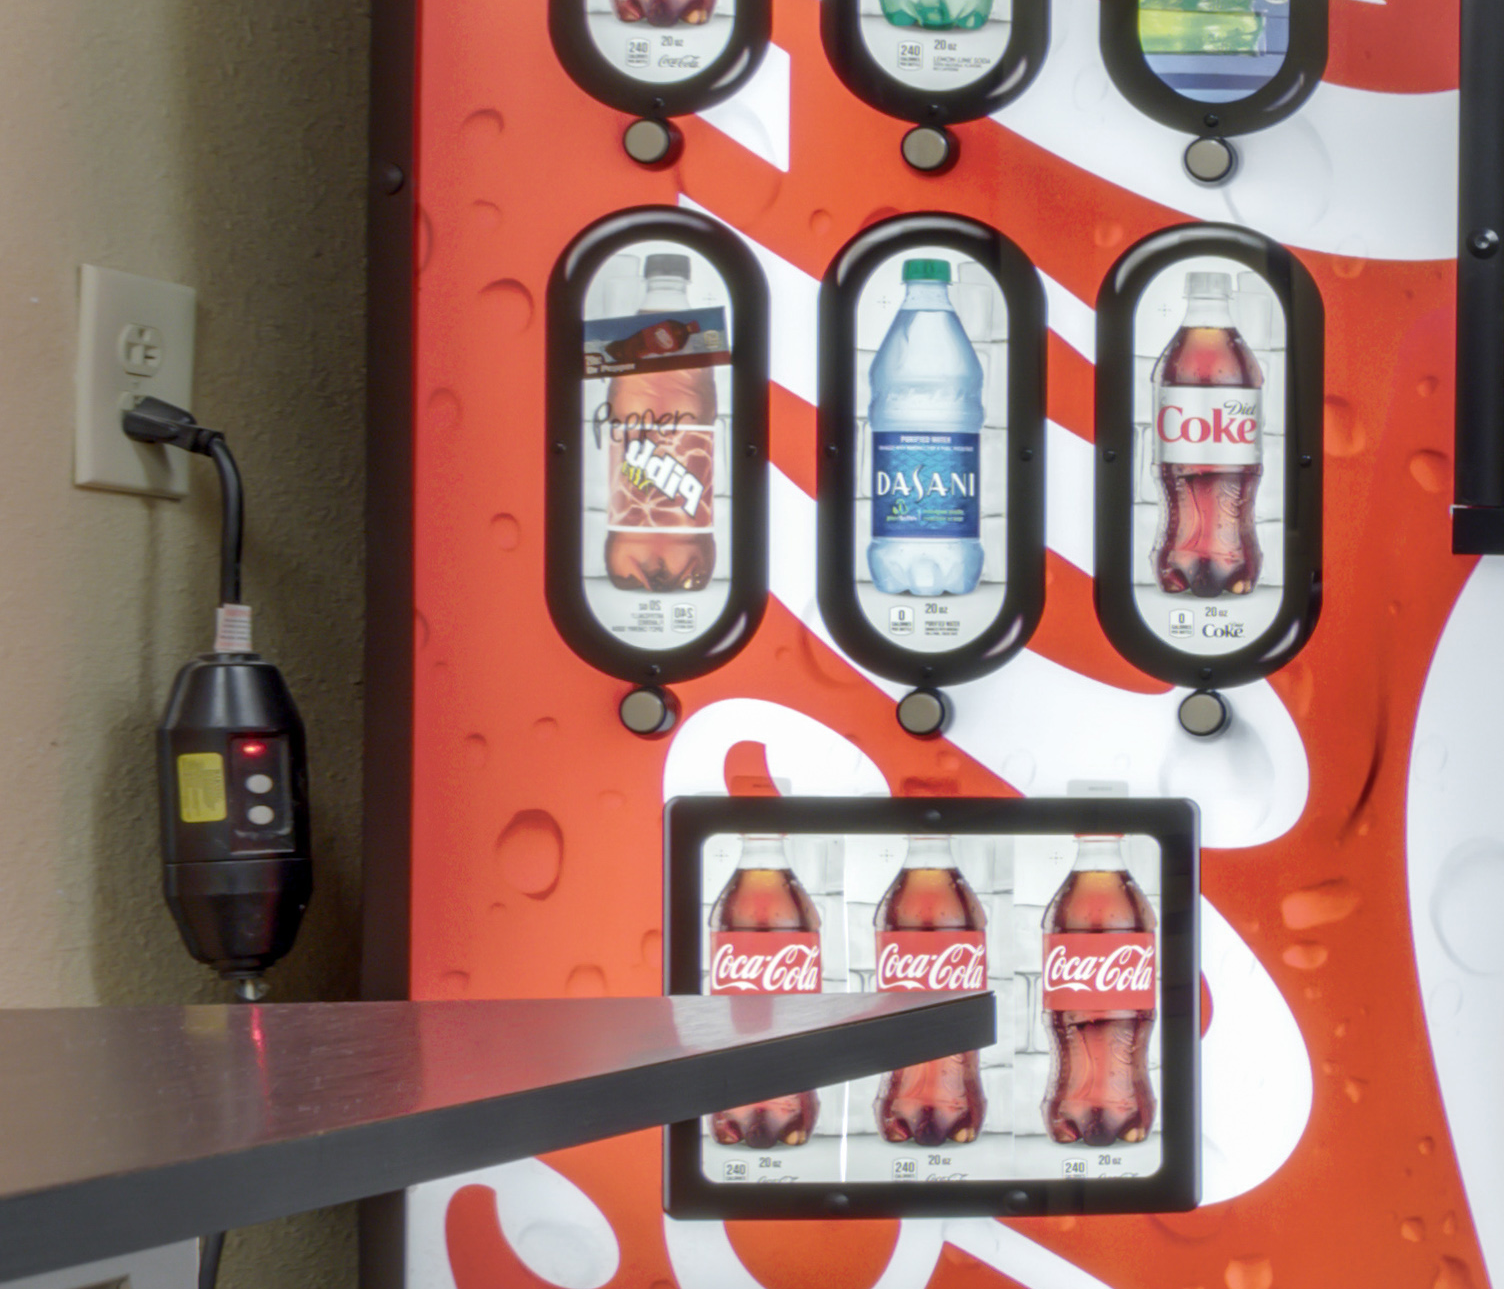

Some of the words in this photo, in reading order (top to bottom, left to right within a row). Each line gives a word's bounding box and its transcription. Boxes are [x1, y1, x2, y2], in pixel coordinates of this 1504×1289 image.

[661, 36, 673, 47] 20
[674, 39, 684, 47] oz
[934, 39, 946, 51] 20
[948, 42, 957, 52] oz
[629, 43, 648, 53] 240
[900, 45, 921, 56] 240
[1223, 400, 1257, 416] Diet
[593, 401, 696, 451] Pepper
[1157, 405, 1257, 445] Coke
[877, 464, 975, 504] DASANI
[925, 604, 937, 614] 20
[938, 606, 948, 614] oz
[1205, 607, 1217, 617] 20
[1218, 610, 1228, 618] oz
[899, 610, 905, 621] 0
[1202, 624, 1244, 638] Coke
[711, 943, 819, 991] Coca-Cola
[877, 943, 986, 991] Coca-Cola
[1043, 945, 1154, 992] Coca-Cola
[759, 1157, 771, 1168] 20
[772, 1160, 781, 1168] oz
[928, 1155, 941, 1165] 20
[942, 1158, 951, 1166] oz
[1098, 1155, 1111, 1165] 20
[726, 1164, 747, 1175] 240
[895, 1161, 915, 1173] 240
[1065, 1161, 1085, 1173] 240
